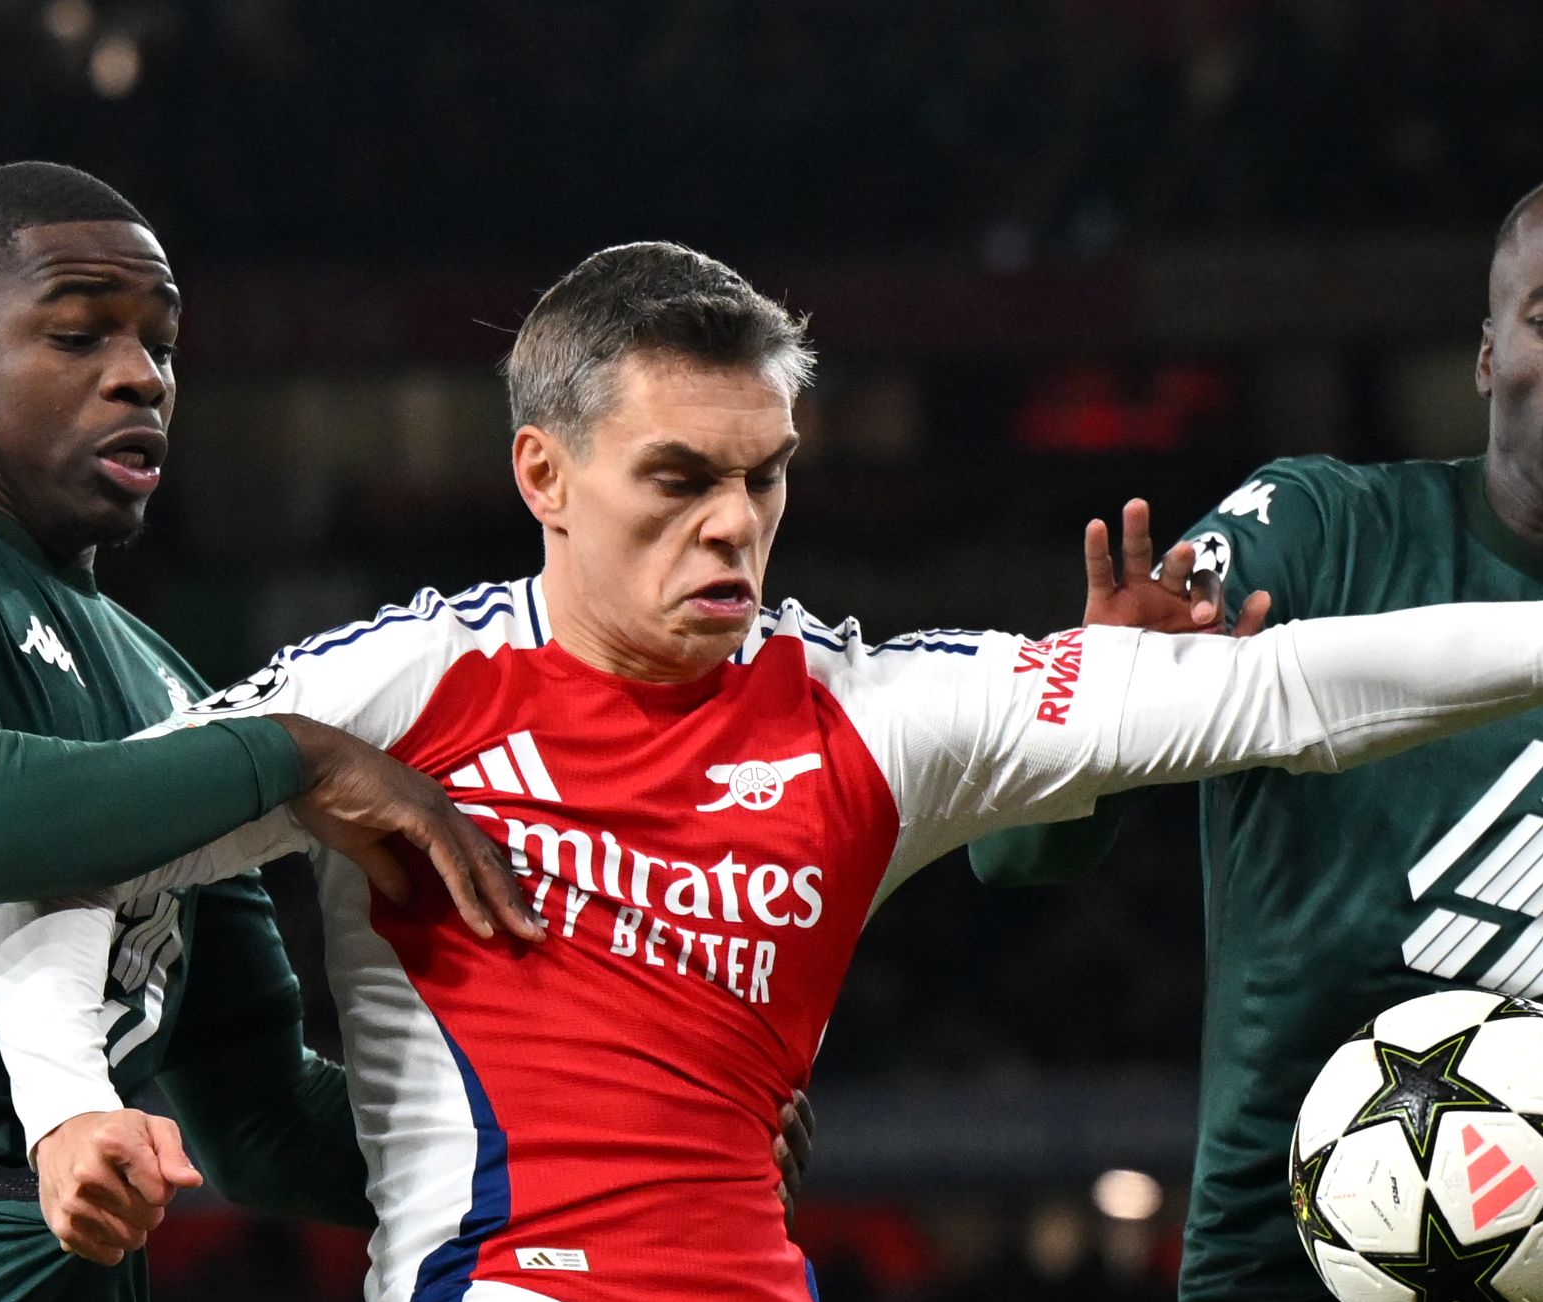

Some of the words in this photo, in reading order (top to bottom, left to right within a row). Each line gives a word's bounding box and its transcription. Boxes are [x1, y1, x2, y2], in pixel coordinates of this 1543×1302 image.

[454, 802, 823, 929] mirates
[532, 874, 591, 938] LY
[610, 906, 776, 1004] BETTER
[1391, 1176, 1400, 1204] PRO
